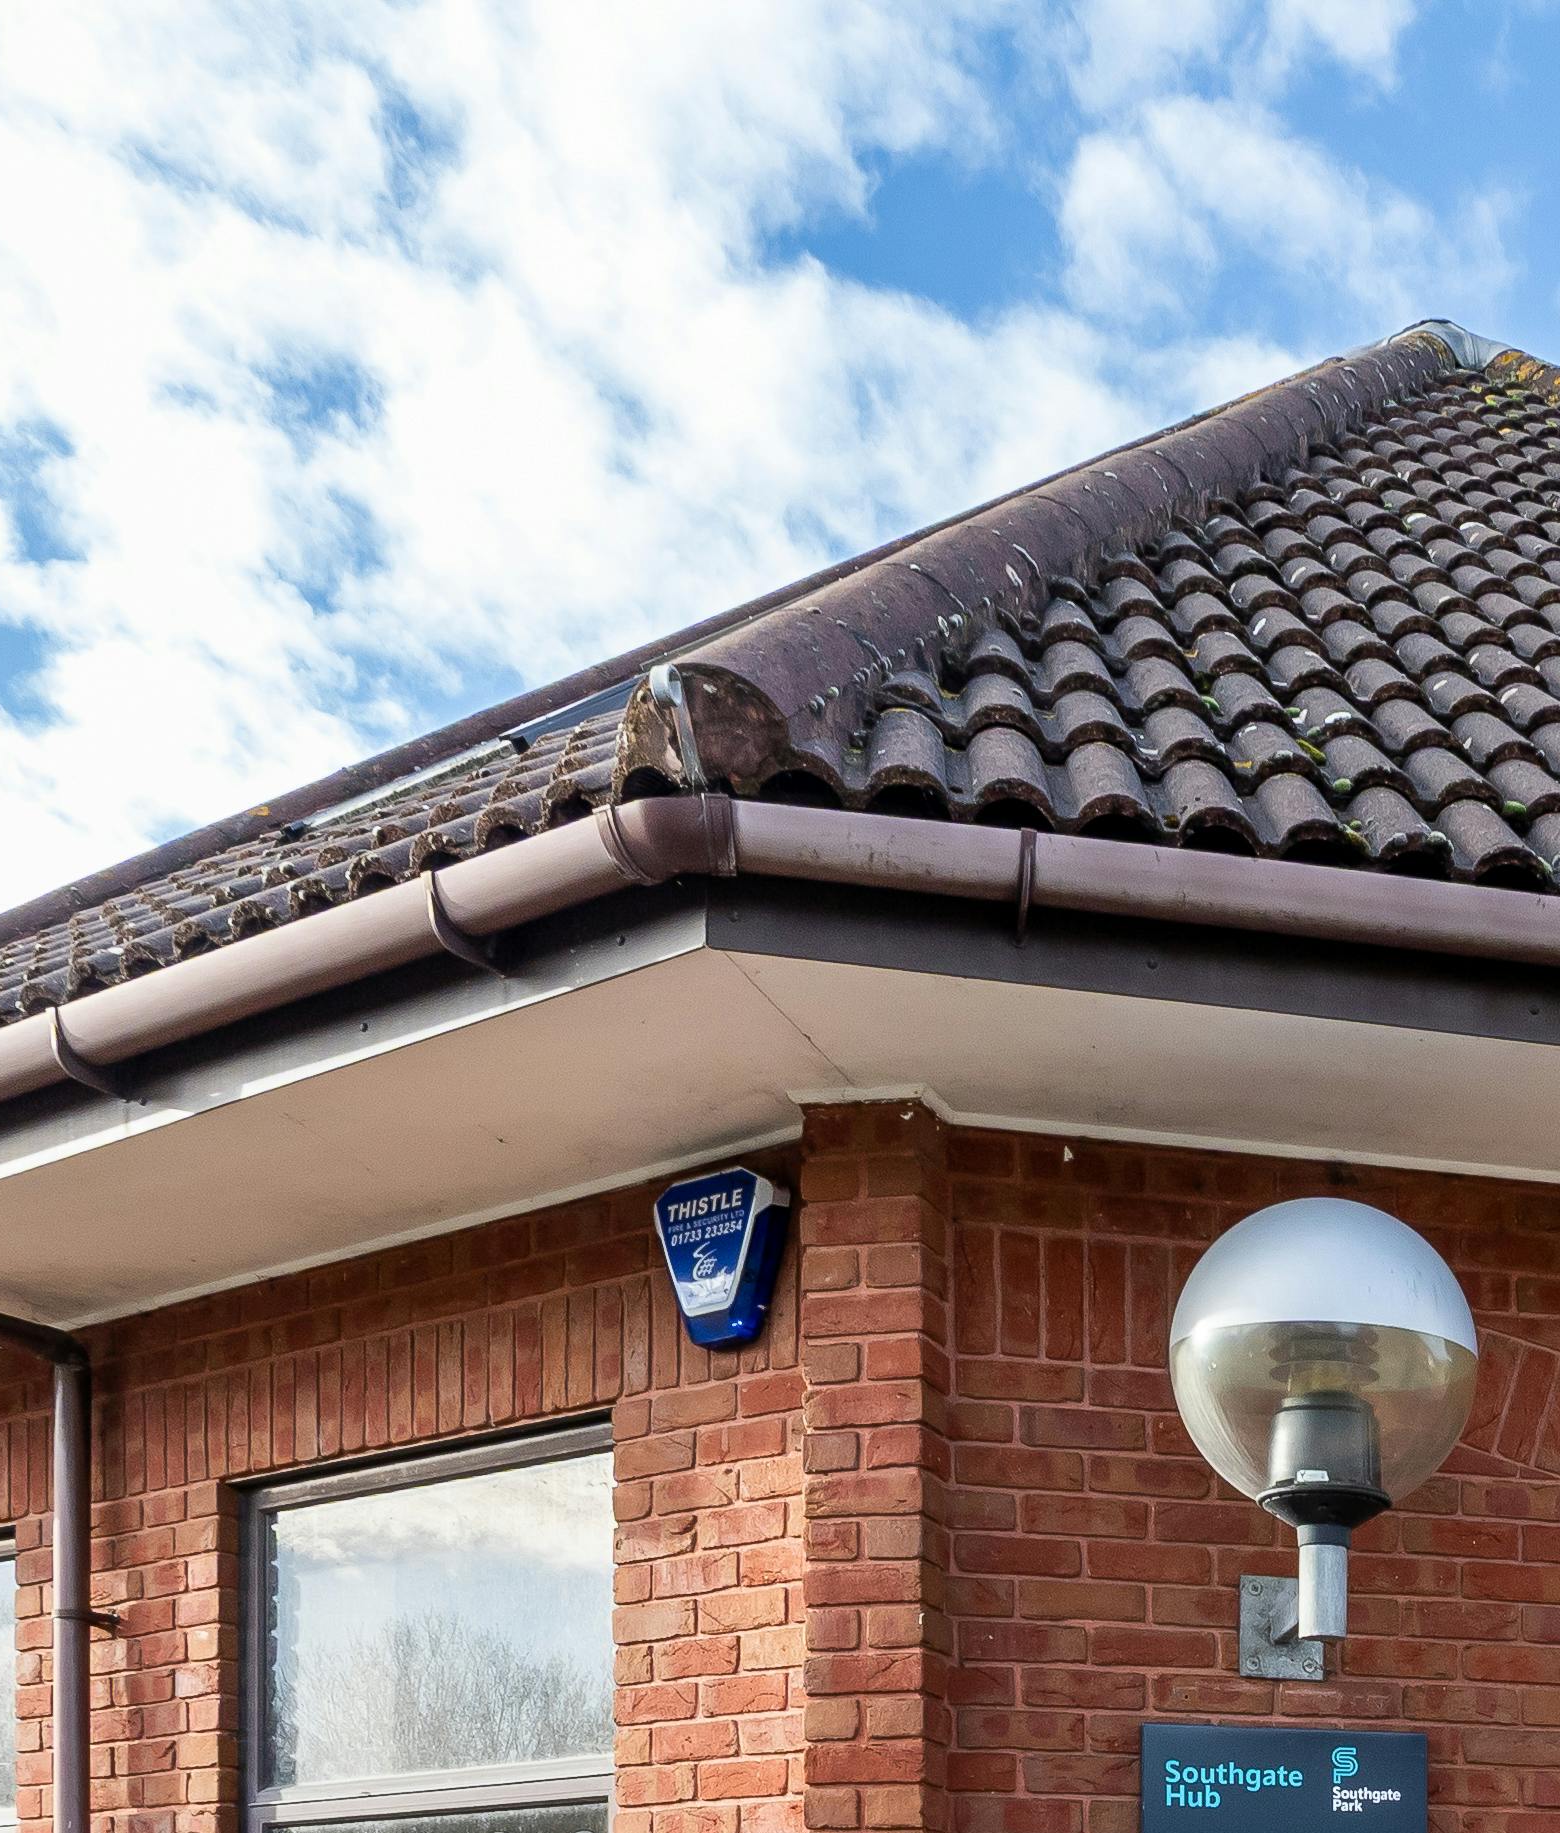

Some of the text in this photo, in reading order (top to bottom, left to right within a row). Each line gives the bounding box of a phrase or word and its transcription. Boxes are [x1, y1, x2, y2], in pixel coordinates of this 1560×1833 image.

[667, 1188, 743, 1223] THISTLE
[730, 1209, 745, 1220] LTD
[671, 1219, 743, 1247] 01733 233254
[1164, 1759, 1304, 1792] Southgate
[1164, 1784, 1222, 1809] Hub
[1332, 1786, 1401, 1804] Southgate
[1332, 1800, 1363, 1813] Park
